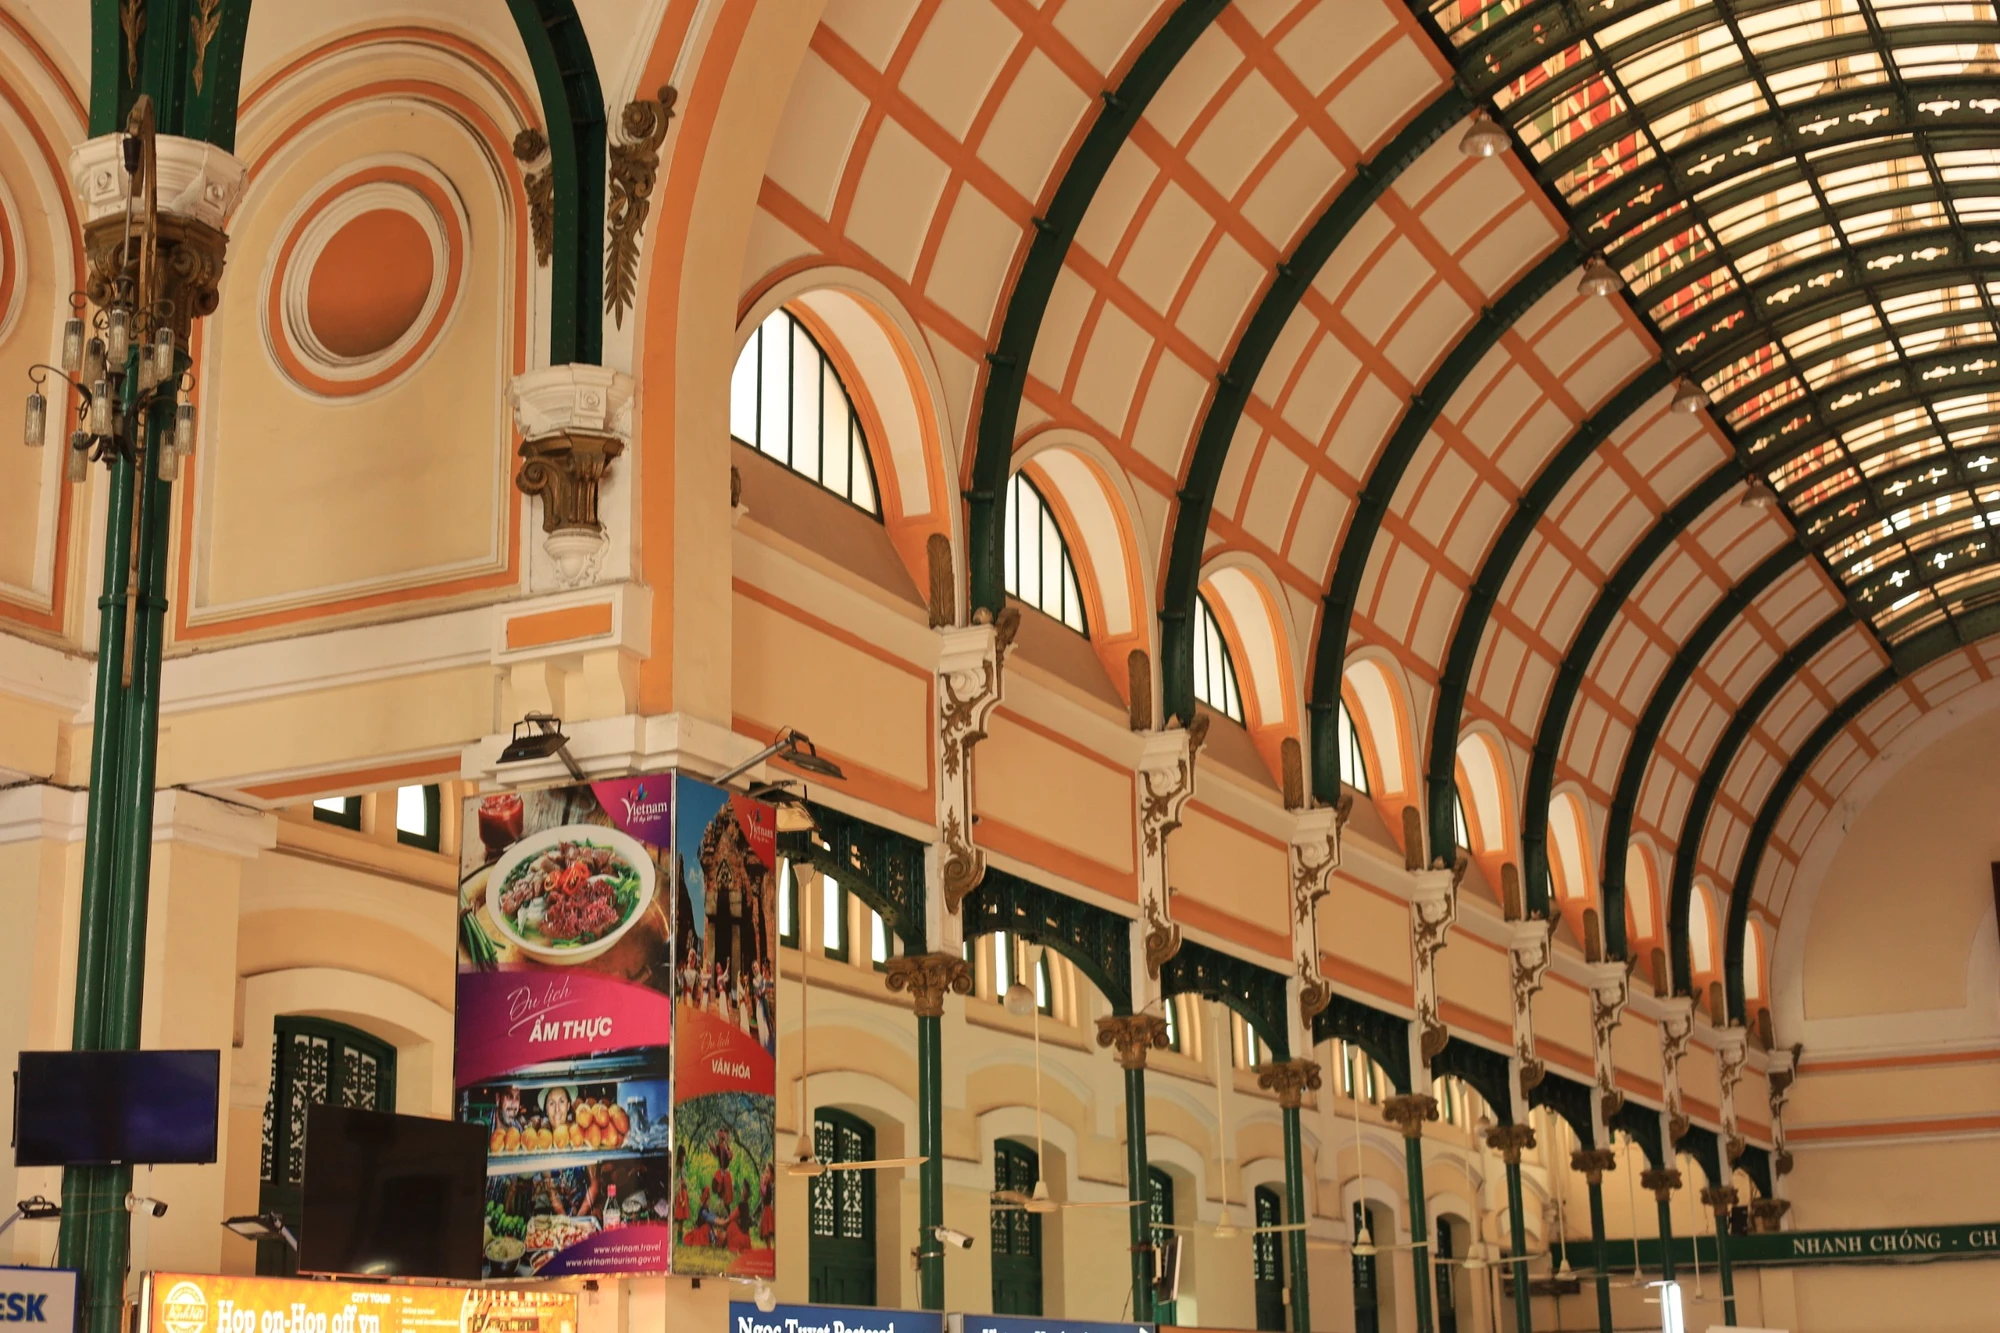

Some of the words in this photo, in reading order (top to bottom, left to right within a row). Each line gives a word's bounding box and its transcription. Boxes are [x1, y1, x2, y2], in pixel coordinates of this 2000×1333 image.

[621, 798, 668, 826] Vietnam
[747, 814, 774, 839] Vietnam
[507, 986, 538, 1021] Du
[543, 976, 571, 1008] lịch
[528, 1014, 559, 1043] ẨM
[562, 1016, 613, 1043] THỰC
[732, 1061, 751, 1080] HÓA
[593, 1240, 662, 1254] www.vietnam.travel
[1793, 1235, 1862, 1255] NHANH
[1870, 1229, 1941, 1251] CHÓNG
[565, 1255, 661, 1268] www.vietnamtourism.gov.vn
[351, 1292, 369, 1303] CITY
[369, 1293, 391, 1305] TOUR
[217, 1299, 256, 1333] Hop
[261, 1303, 327, 1333] on-Hop
[331, 1304, 358, 1333] off
